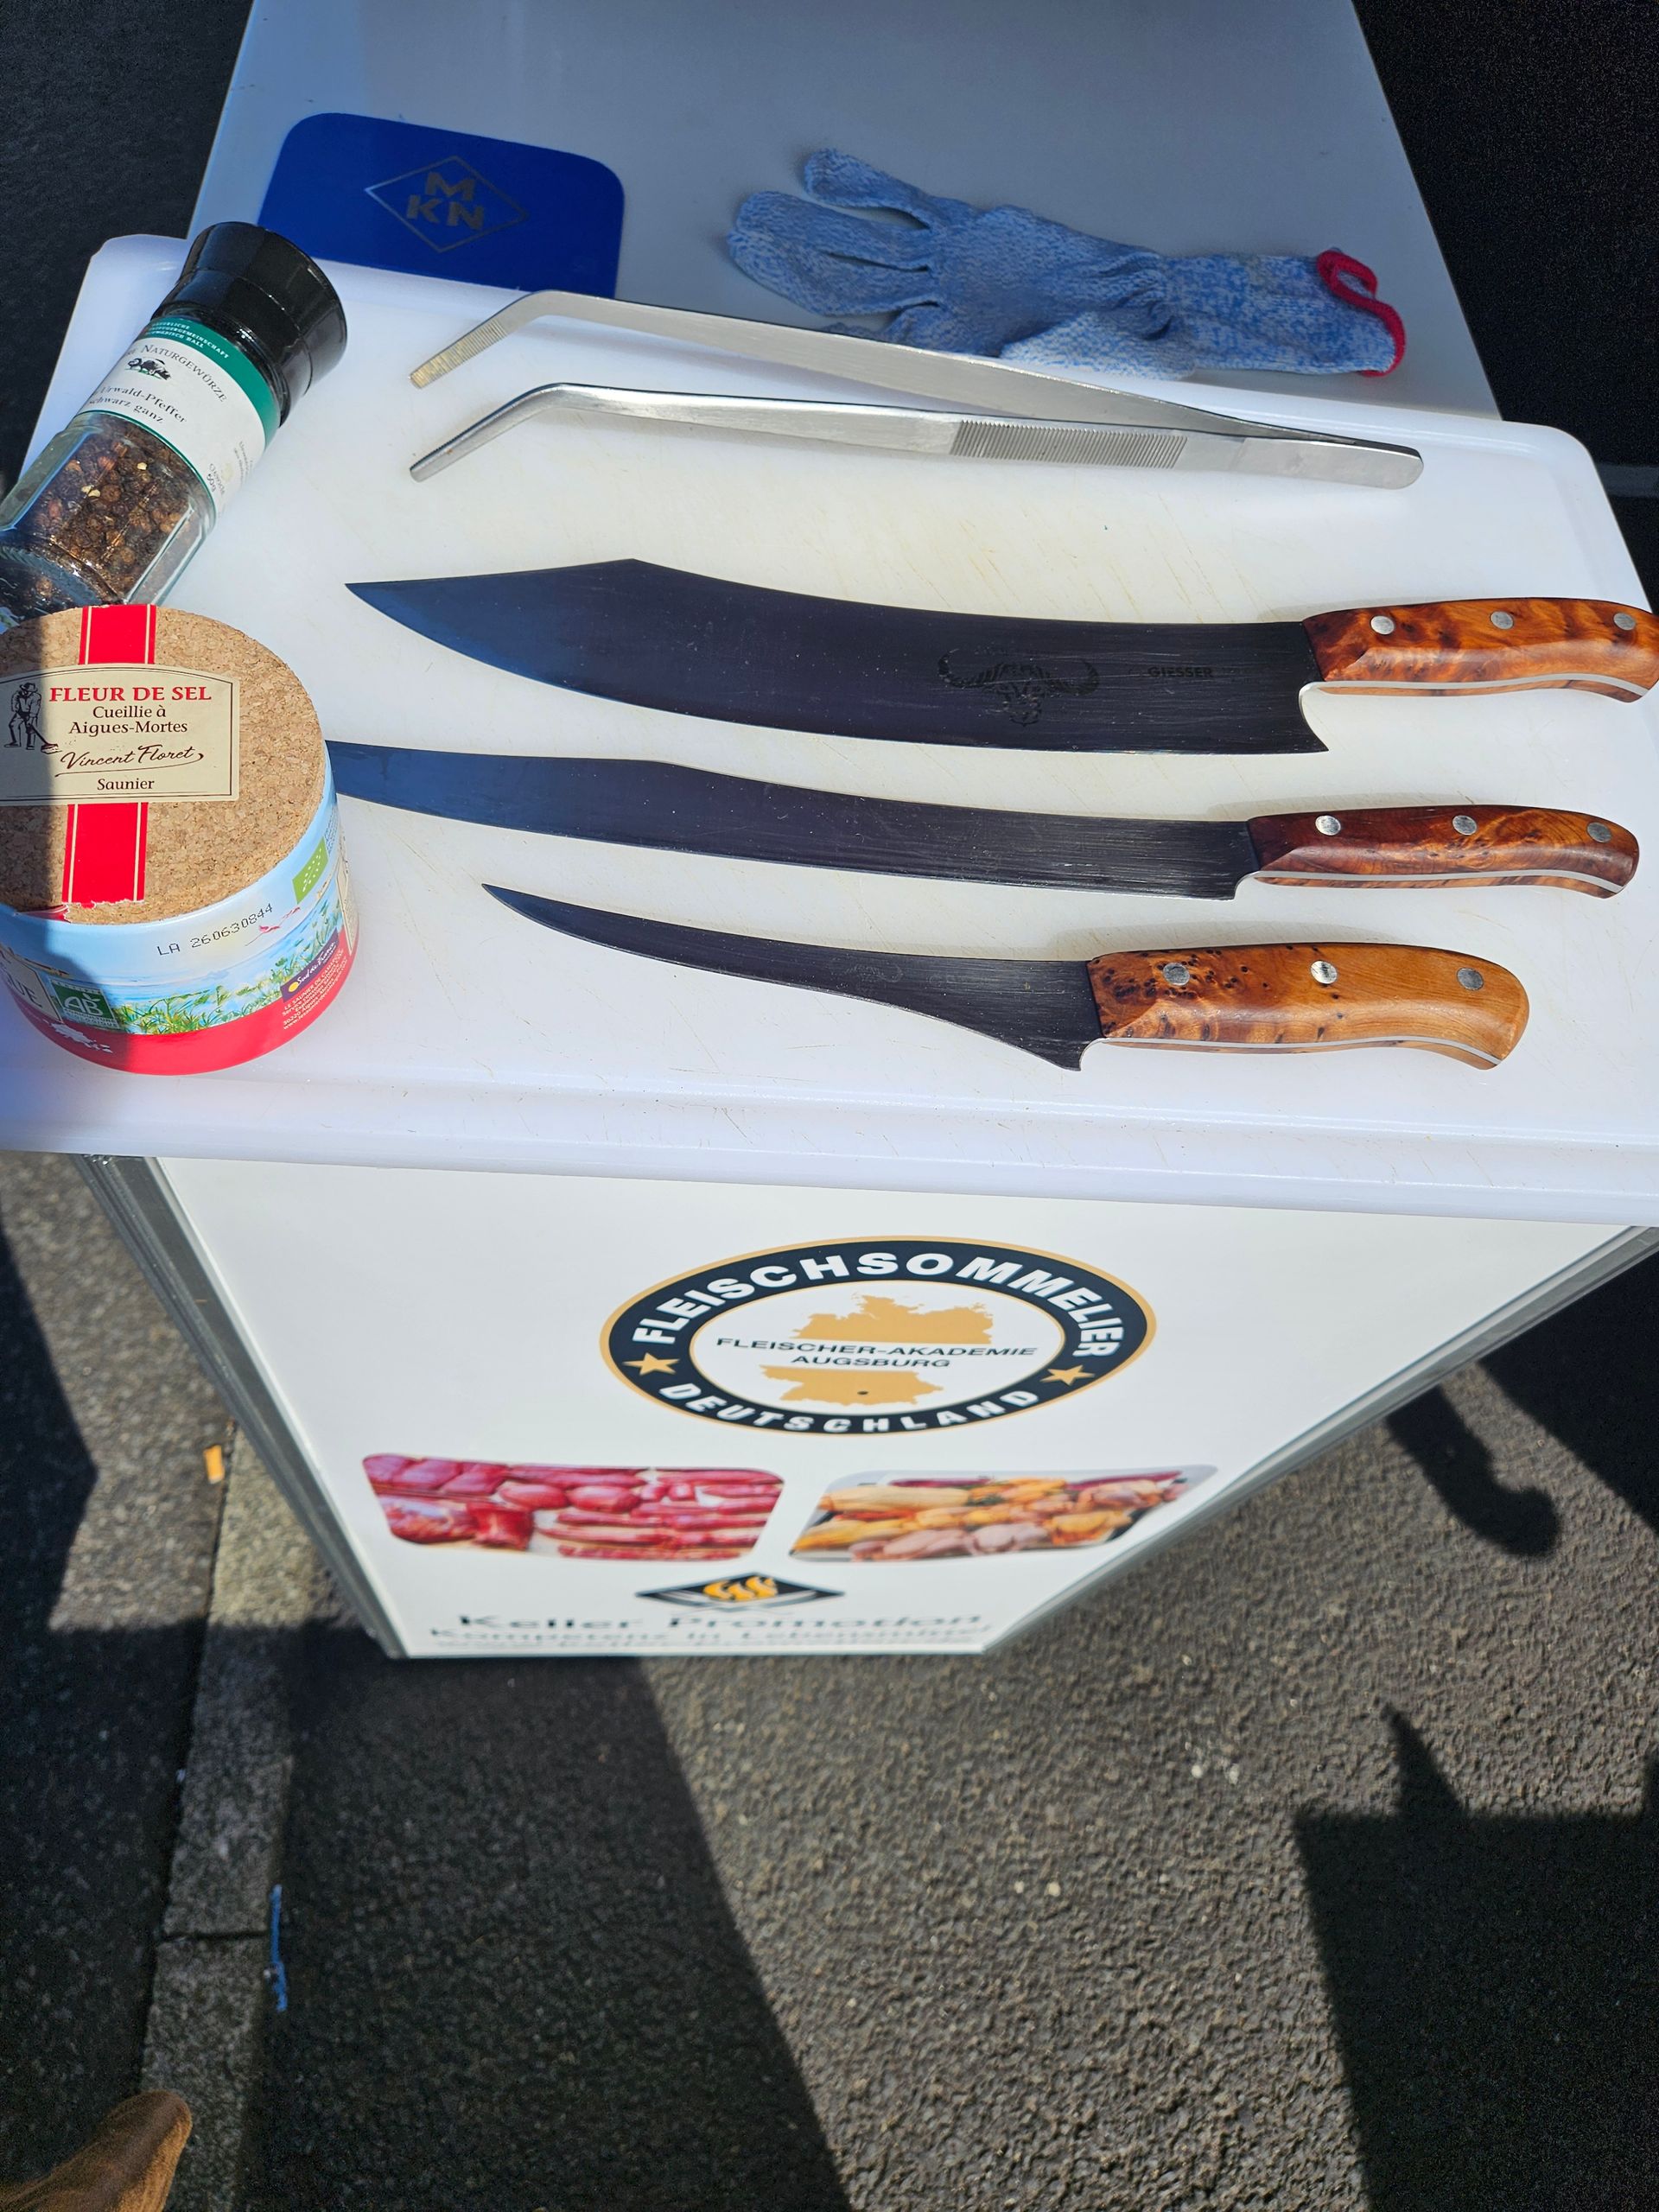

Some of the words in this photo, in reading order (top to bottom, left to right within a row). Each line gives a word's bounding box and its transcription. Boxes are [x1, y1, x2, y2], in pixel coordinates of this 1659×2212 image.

[186, 335, 206, 349] HALL
[133, 404, 164, 424] ganz
[1147, 666, 1215, 678] GIESSER
[48, 687, 125, 702] FLEUR
[132, 686, 165, 702] DE
[171, 685, 212, 702] SEL
[92, 705, 152, 719] Cueillie
[156, 704, 167, 718] à
[68, 721, 188, 738] Aigues-Mortes
[60, 750, 137, 770] Vincent
[137, 744, 196, 764] Floret
[97, 778, 155, 791] Saunier
[156, 943, 181, 956] LA
[190, 903, 273, 949] 260630844
[64, 995, 104, 1016] AB
[632, 1252, 1124, 1358] FLEISCHSOMMELIER
[715, 1338, 1038, 1357] FLEISCHER-AKADEMIE
[791, 1355, 951, 1368] AUGSBURG
[658, 1382, 1039, 1433] DEUTSCHLAND
[460, 1615, 641, 1630] Keller
[668, 1614, 982, 1630] Promotion
